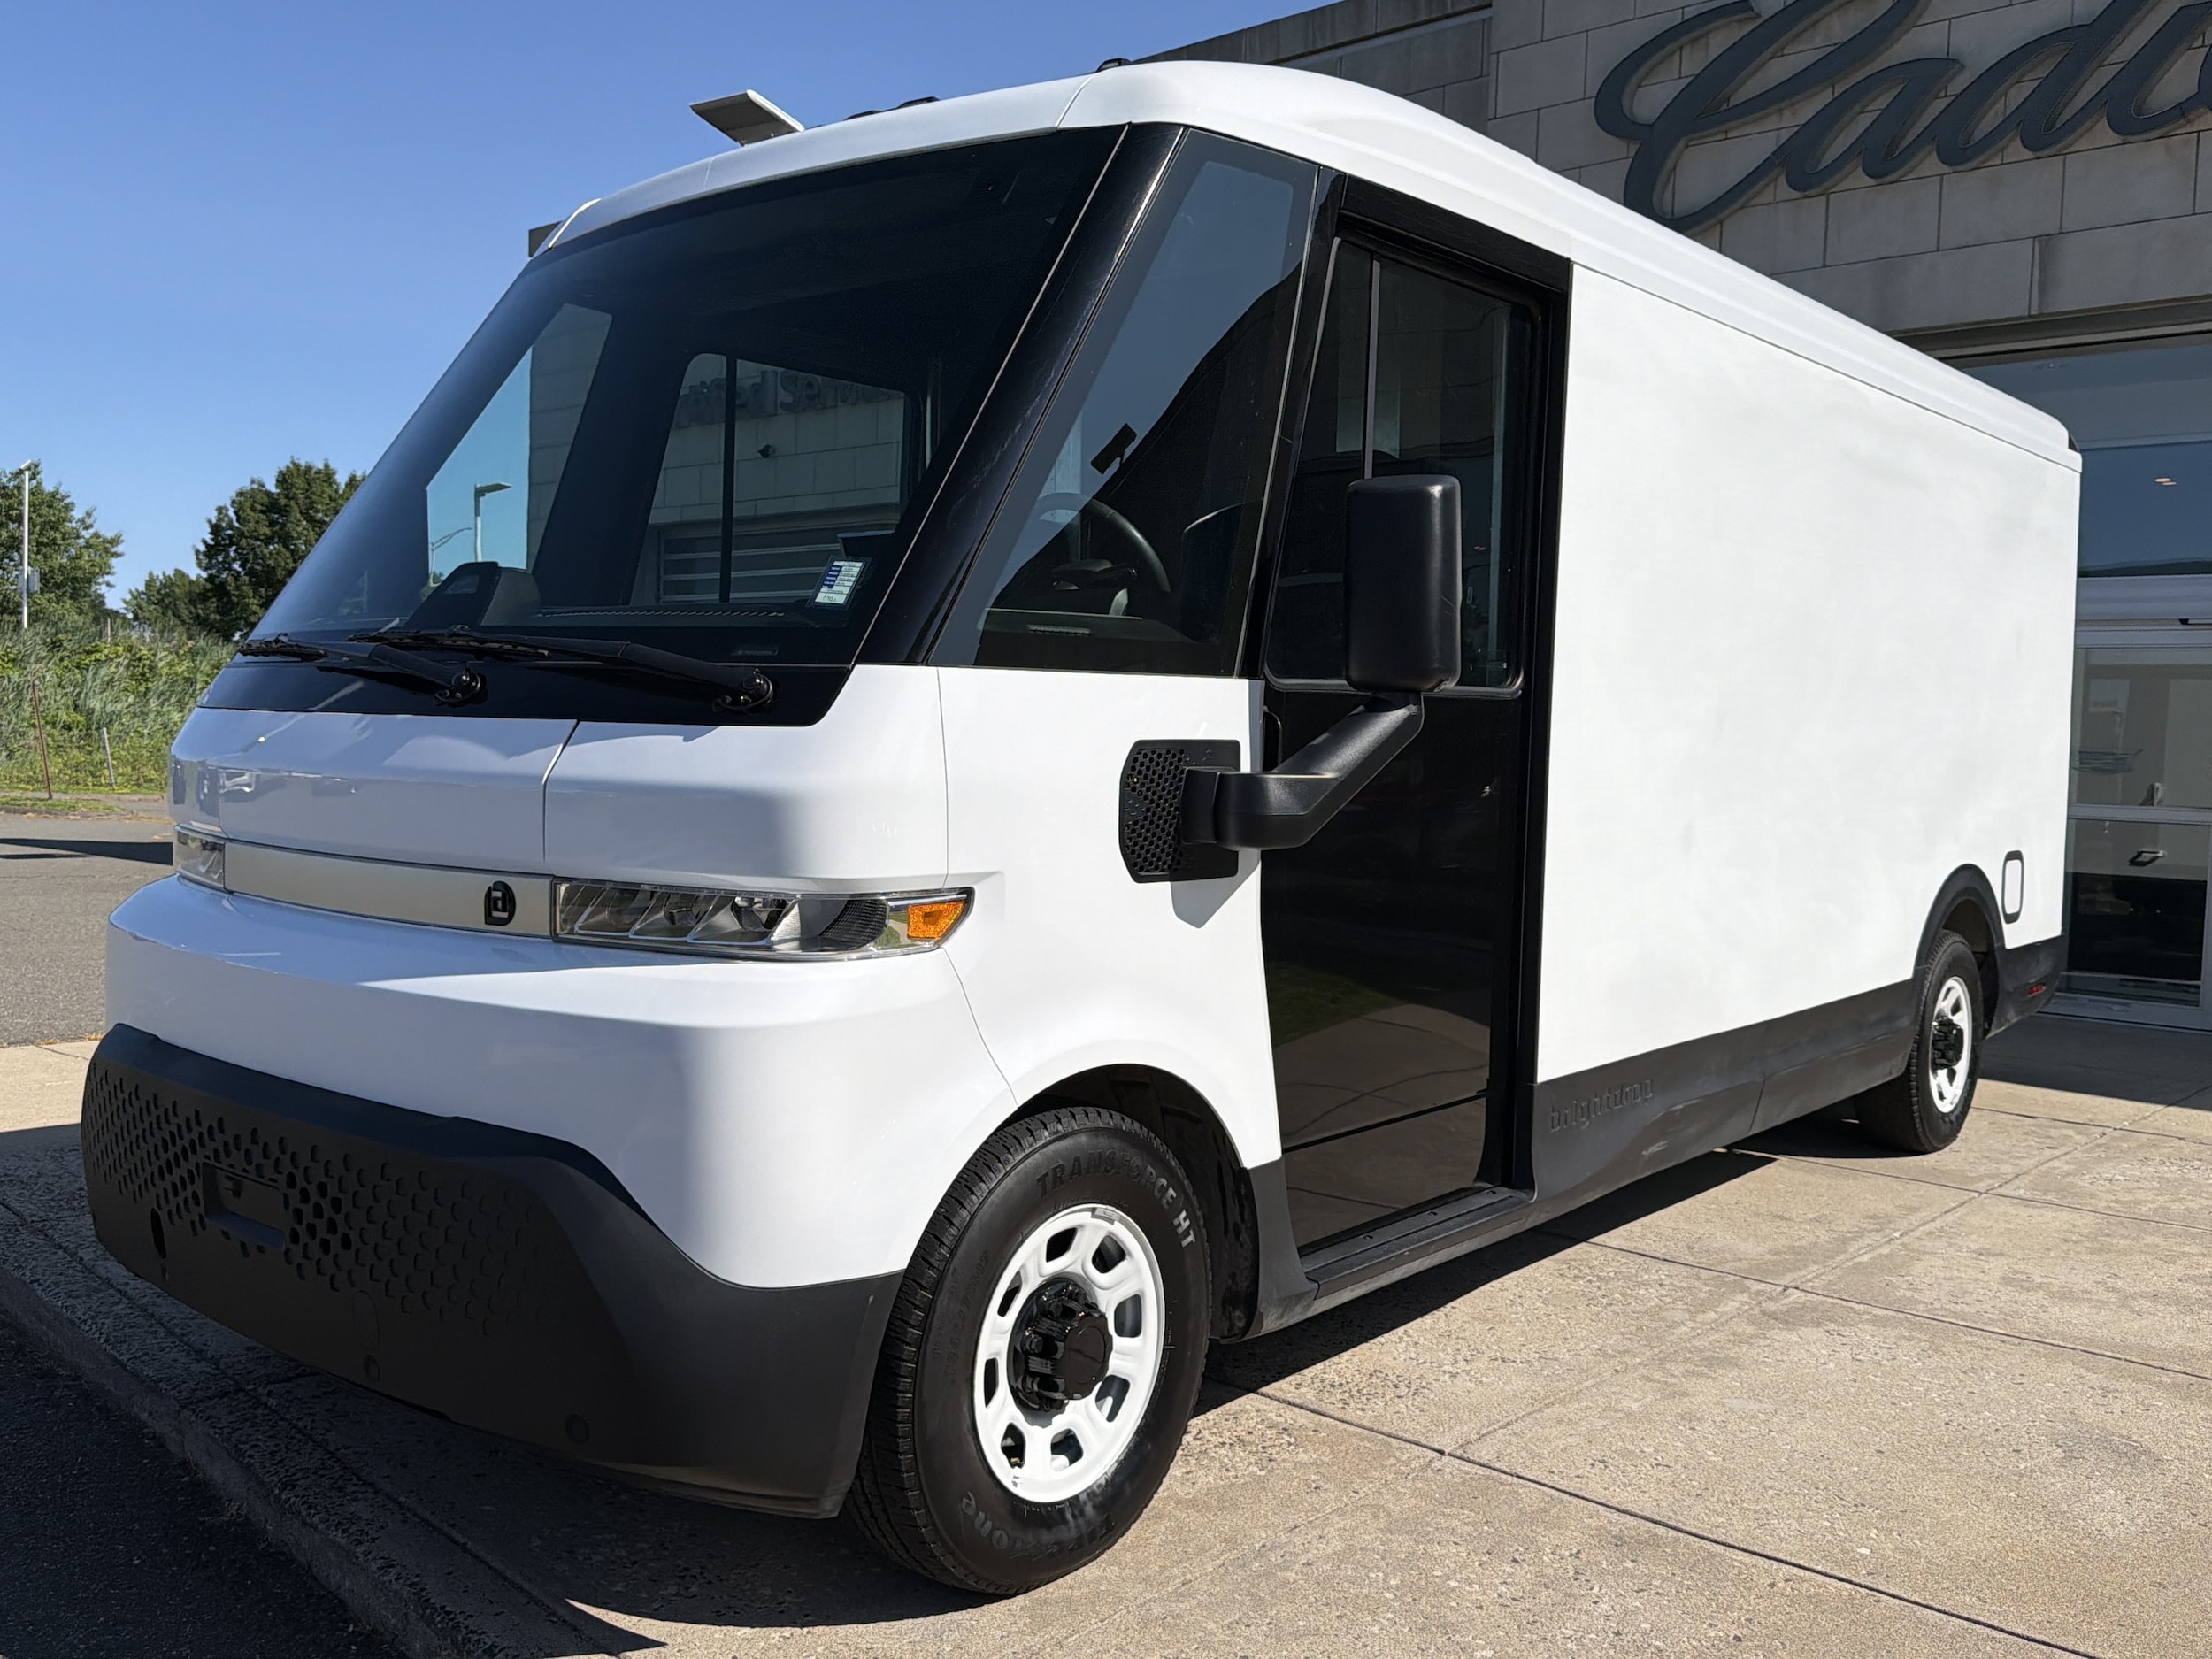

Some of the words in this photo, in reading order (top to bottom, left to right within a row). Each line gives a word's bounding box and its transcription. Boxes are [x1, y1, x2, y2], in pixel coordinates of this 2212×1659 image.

[1594, 0, 2212, 227] Cadi
[1549, 1079, 1653, 1133] brightdrop
[1035, 1149, 1178, 1210] TRANSFORCE
[1172, 1209, 1196, 1248] HT
